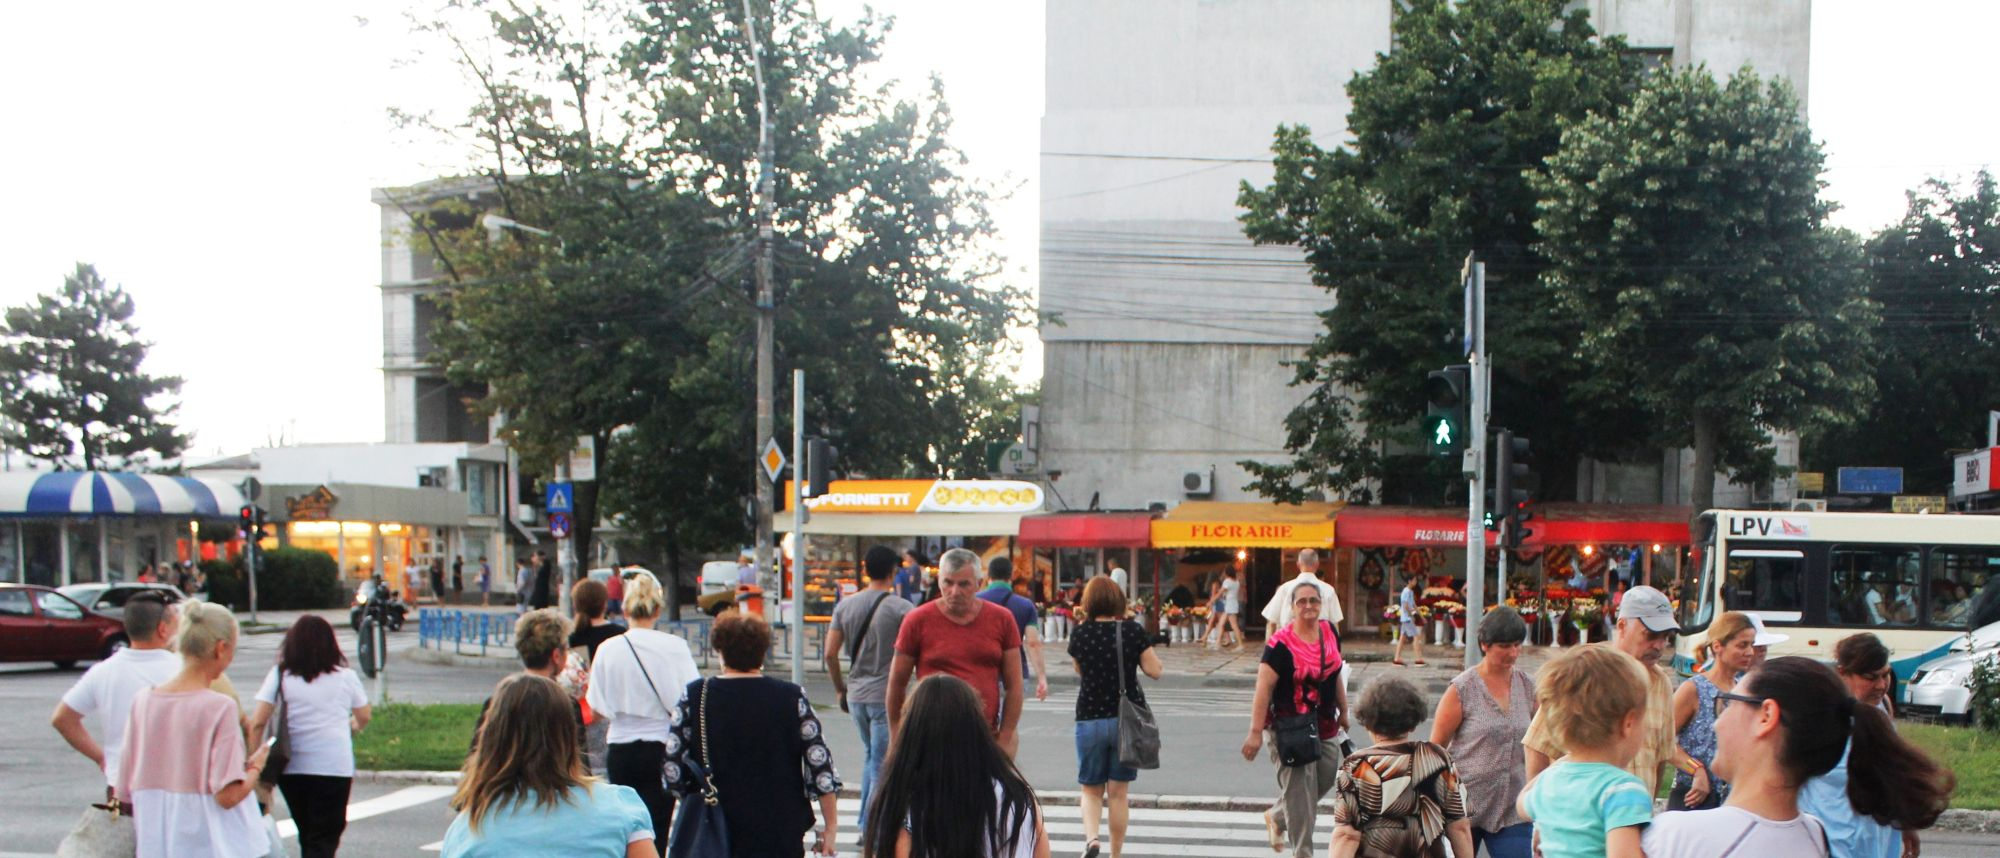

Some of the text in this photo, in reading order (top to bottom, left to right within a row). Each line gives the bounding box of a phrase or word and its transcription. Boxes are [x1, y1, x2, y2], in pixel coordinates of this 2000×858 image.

[820, 493, 911, 506] FORNETTI
[1190, 525, 1293, 538] FLORARIE
[1729, 517, 1772, 535] LPV
[1415, 529, 1466, 541] FLORARIE
